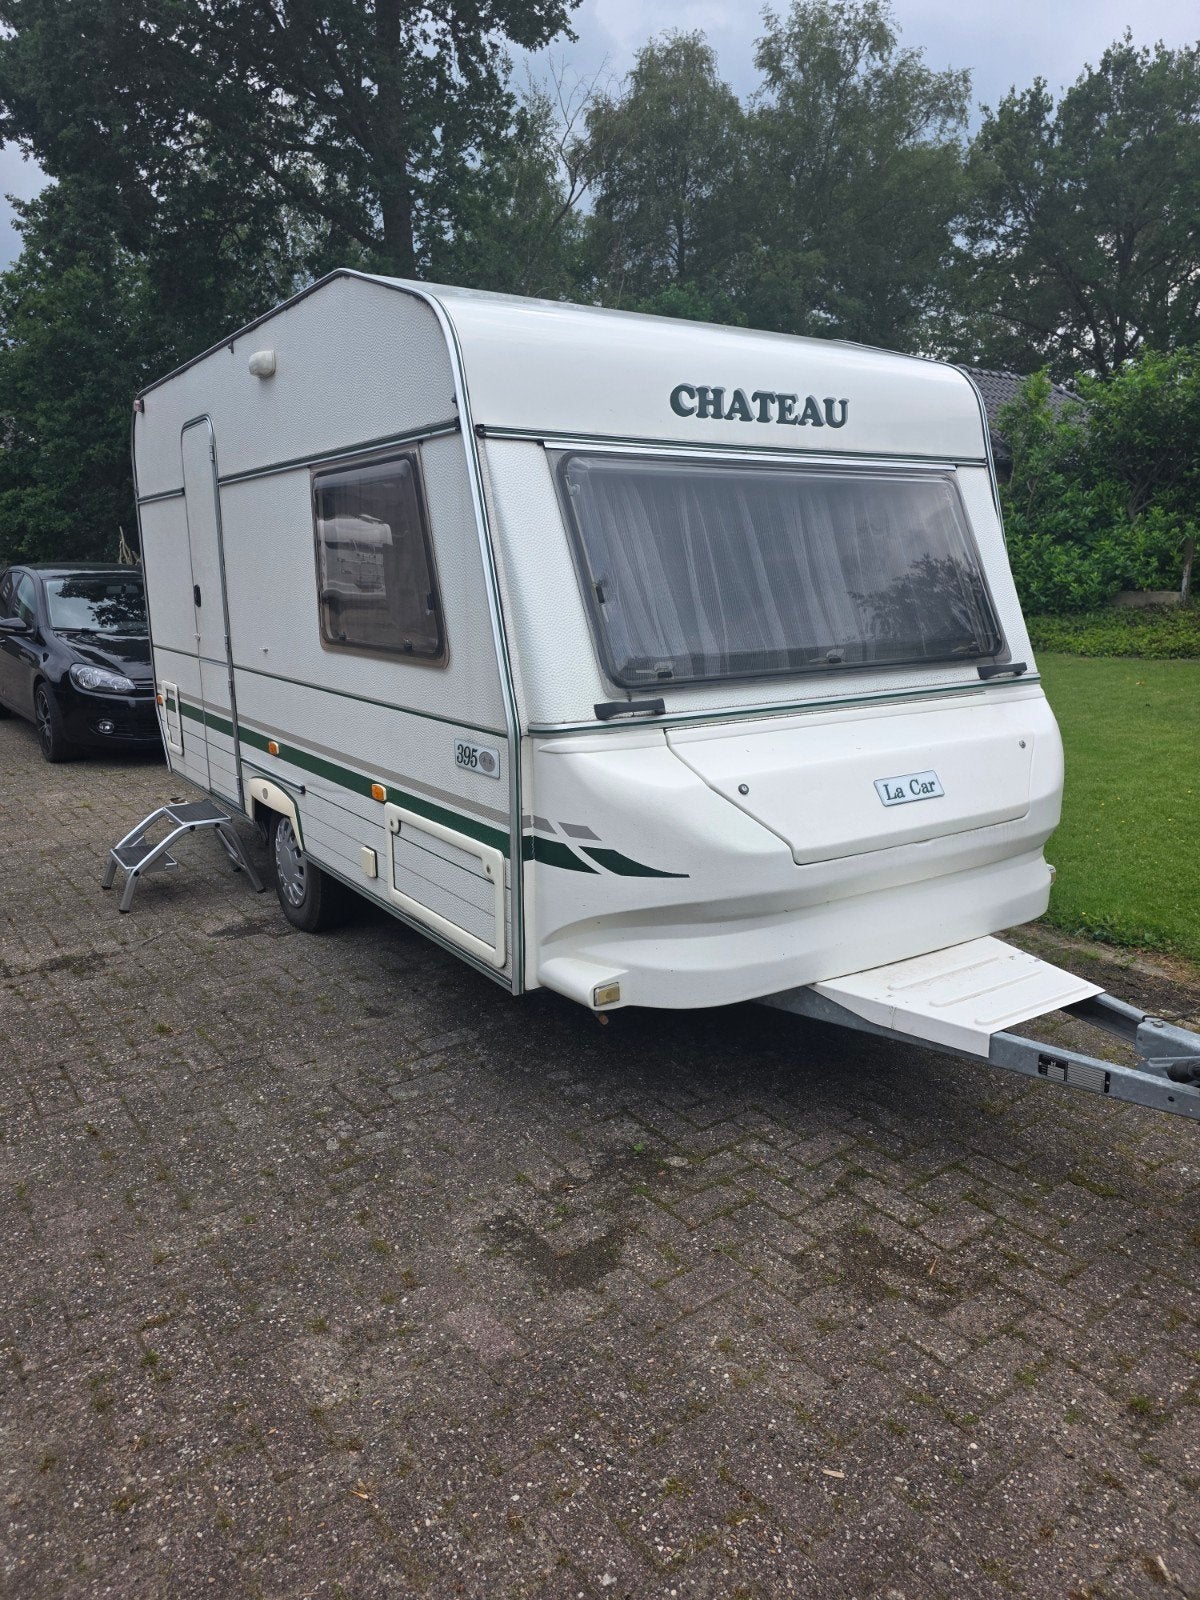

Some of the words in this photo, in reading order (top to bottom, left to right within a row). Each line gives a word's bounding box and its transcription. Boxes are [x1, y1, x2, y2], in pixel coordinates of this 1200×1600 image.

[670, 383, 850, 429] CHATEAU
[456, 743, 478, 768] 395
[883, 783, 906, 801] La
[909, 778, 936, 796] Car
